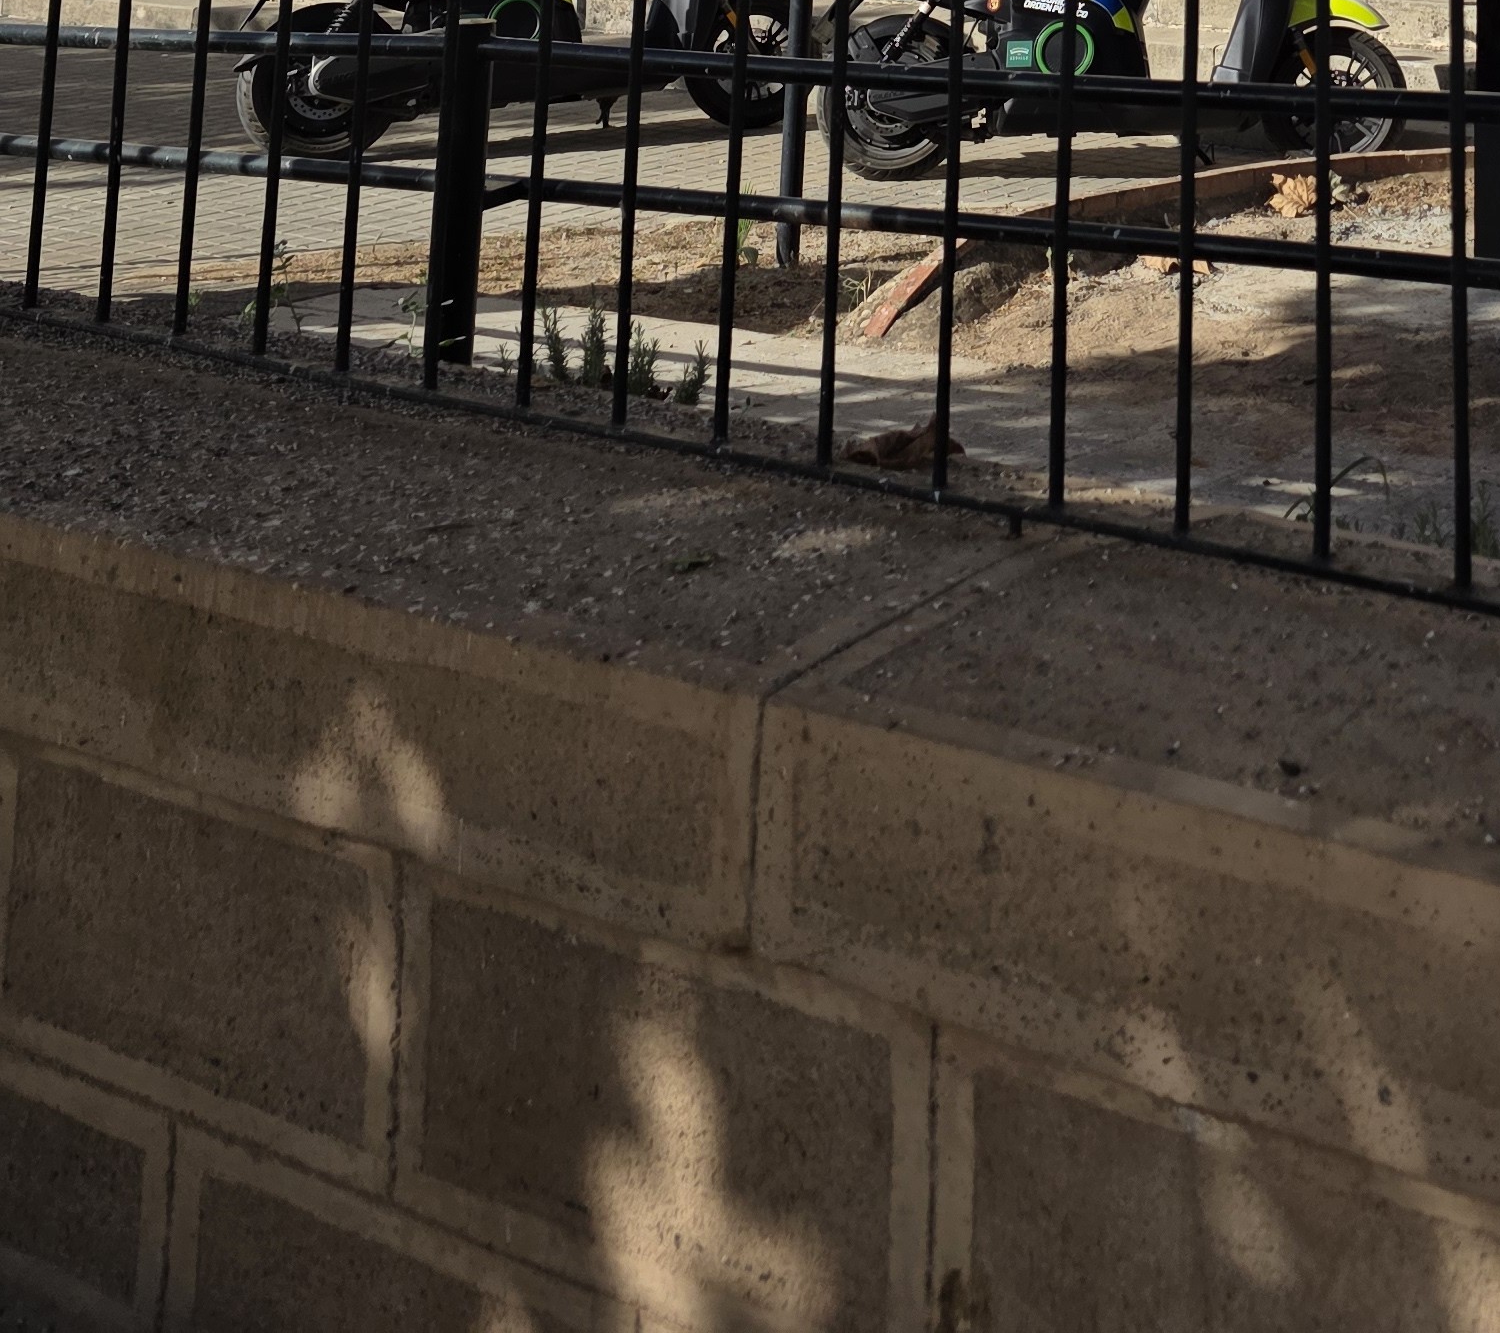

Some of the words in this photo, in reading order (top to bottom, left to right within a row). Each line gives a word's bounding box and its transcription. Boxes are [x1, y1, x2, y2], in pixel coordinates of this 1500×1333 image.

[1023, 0, 1052, 12] ORDEN
[1052, 4, 1089, 19] PUCO
[1078, 2, 1086, 11] Y
